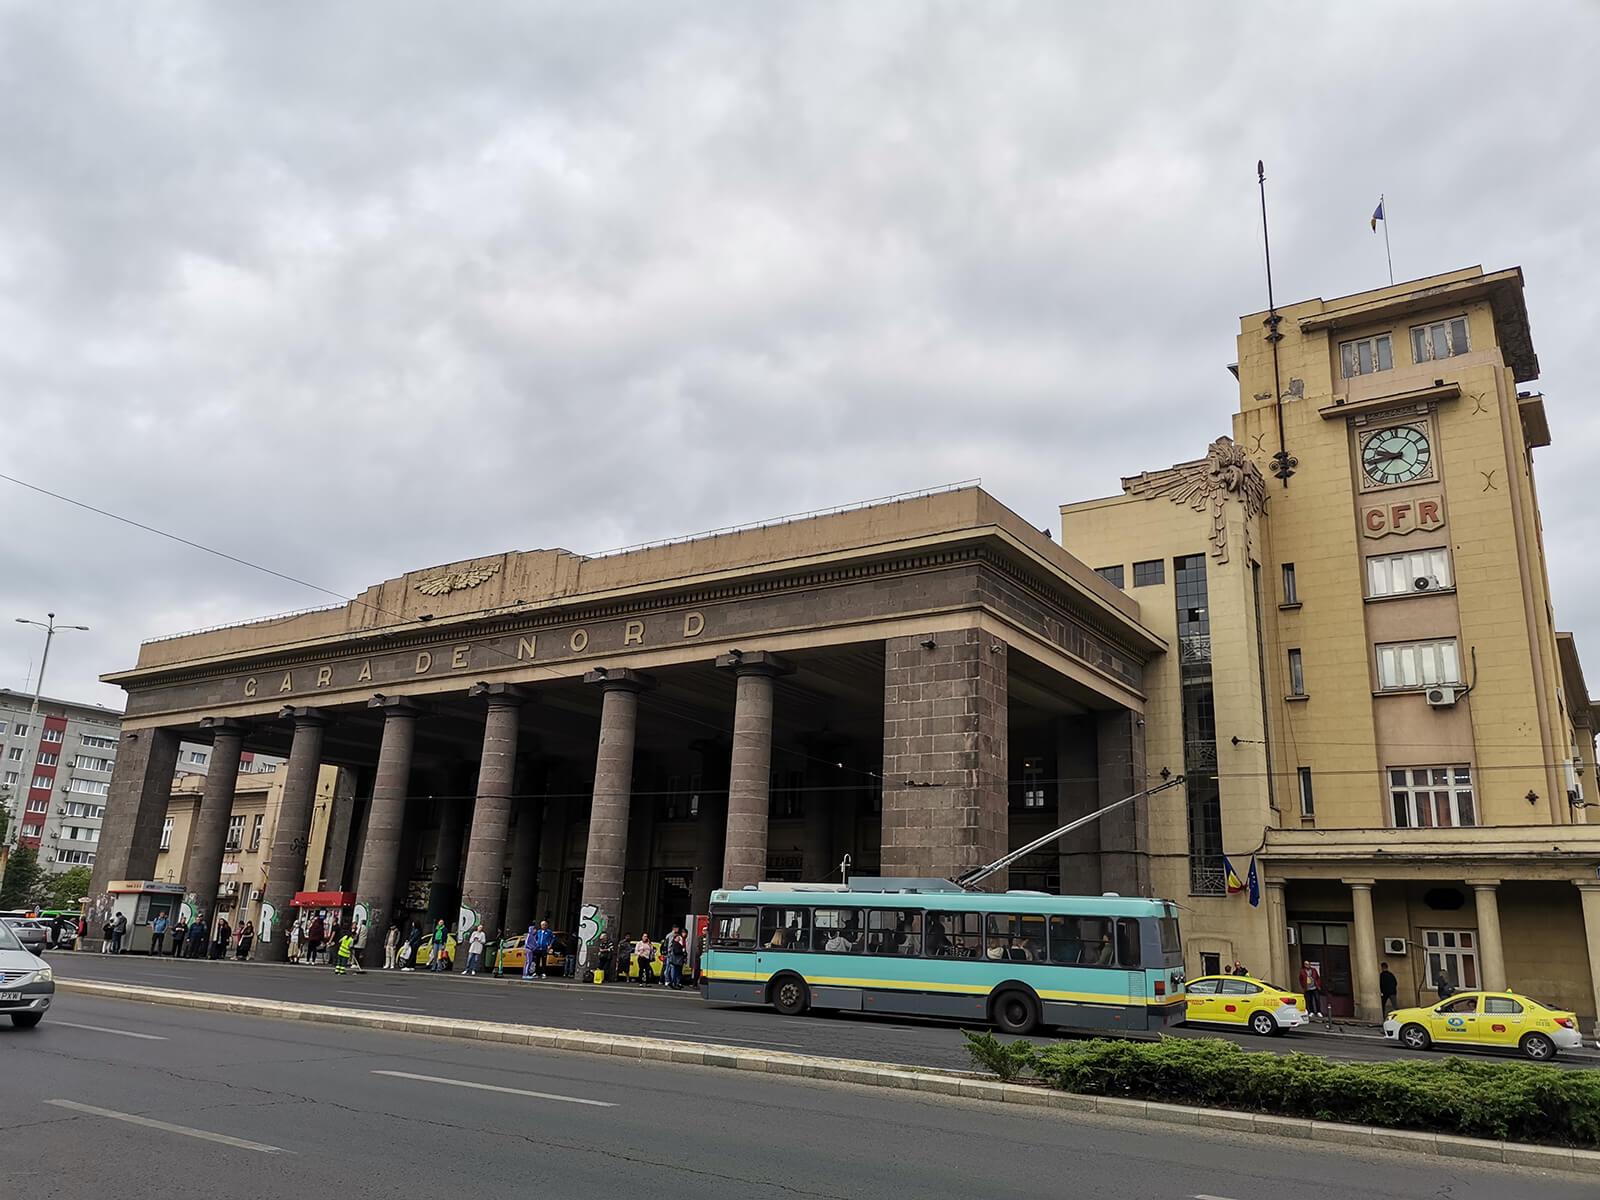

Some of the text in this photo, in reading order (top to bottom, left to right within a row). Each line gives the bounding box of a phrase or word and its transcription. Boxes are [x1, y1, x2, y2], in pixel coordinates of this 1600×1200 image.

[1366, 501, 1440, 531] CFR
[244, 611, 706, 697] GARA DE NORD
